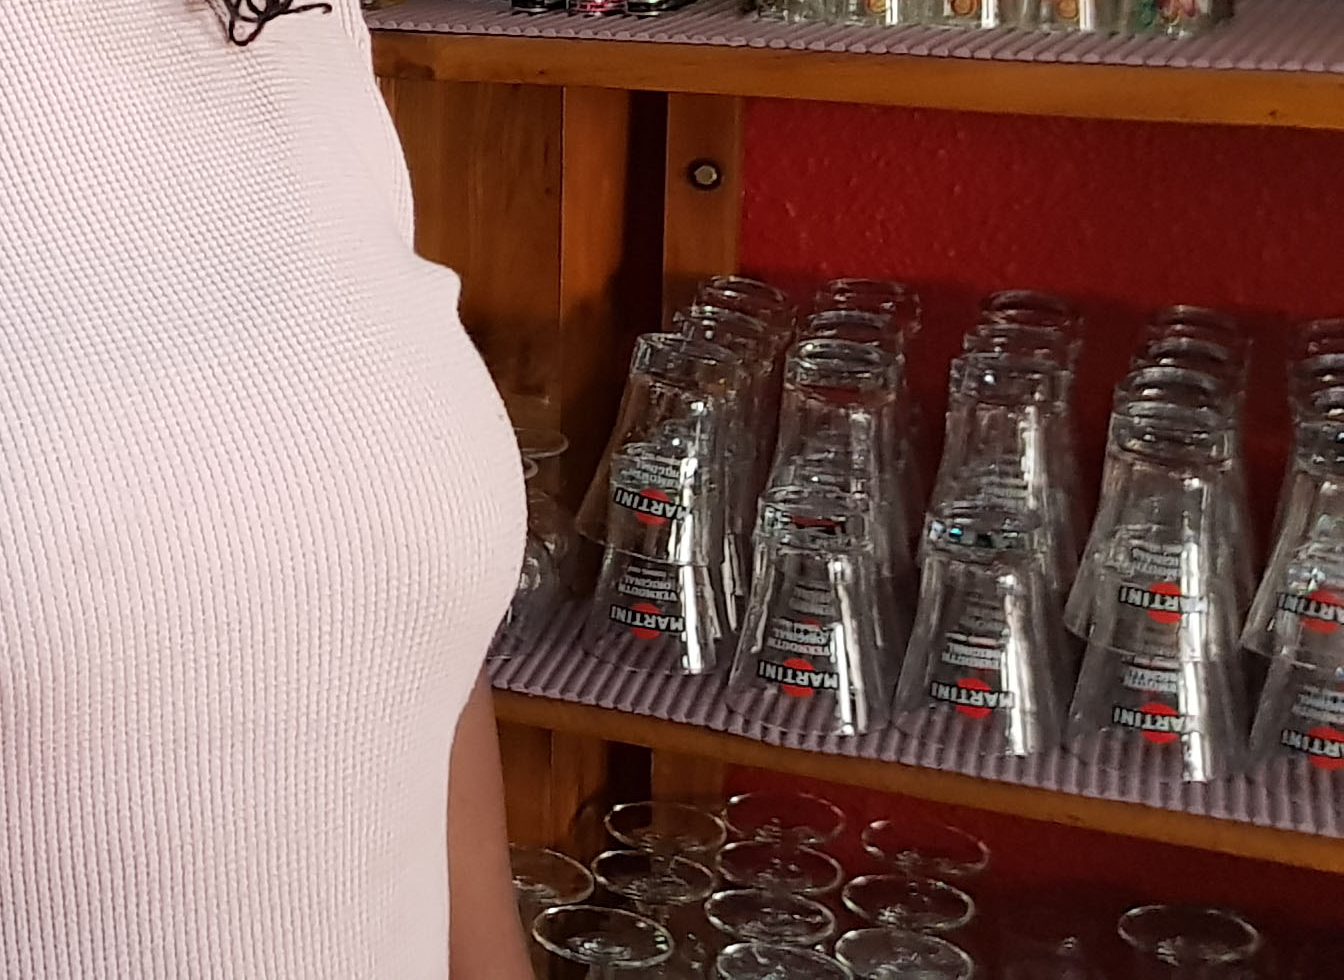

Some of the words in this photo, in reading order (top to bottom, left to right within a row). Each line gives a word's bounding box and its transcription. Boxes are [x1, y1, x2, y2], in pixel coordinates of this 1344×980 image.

[615, 488, 691, 521] MARTINI
[611, 605, 685, 632] MARTINI
[759, 660, 839, 689] MARTINI
[931, 681, 1015, 709] MARTINI
